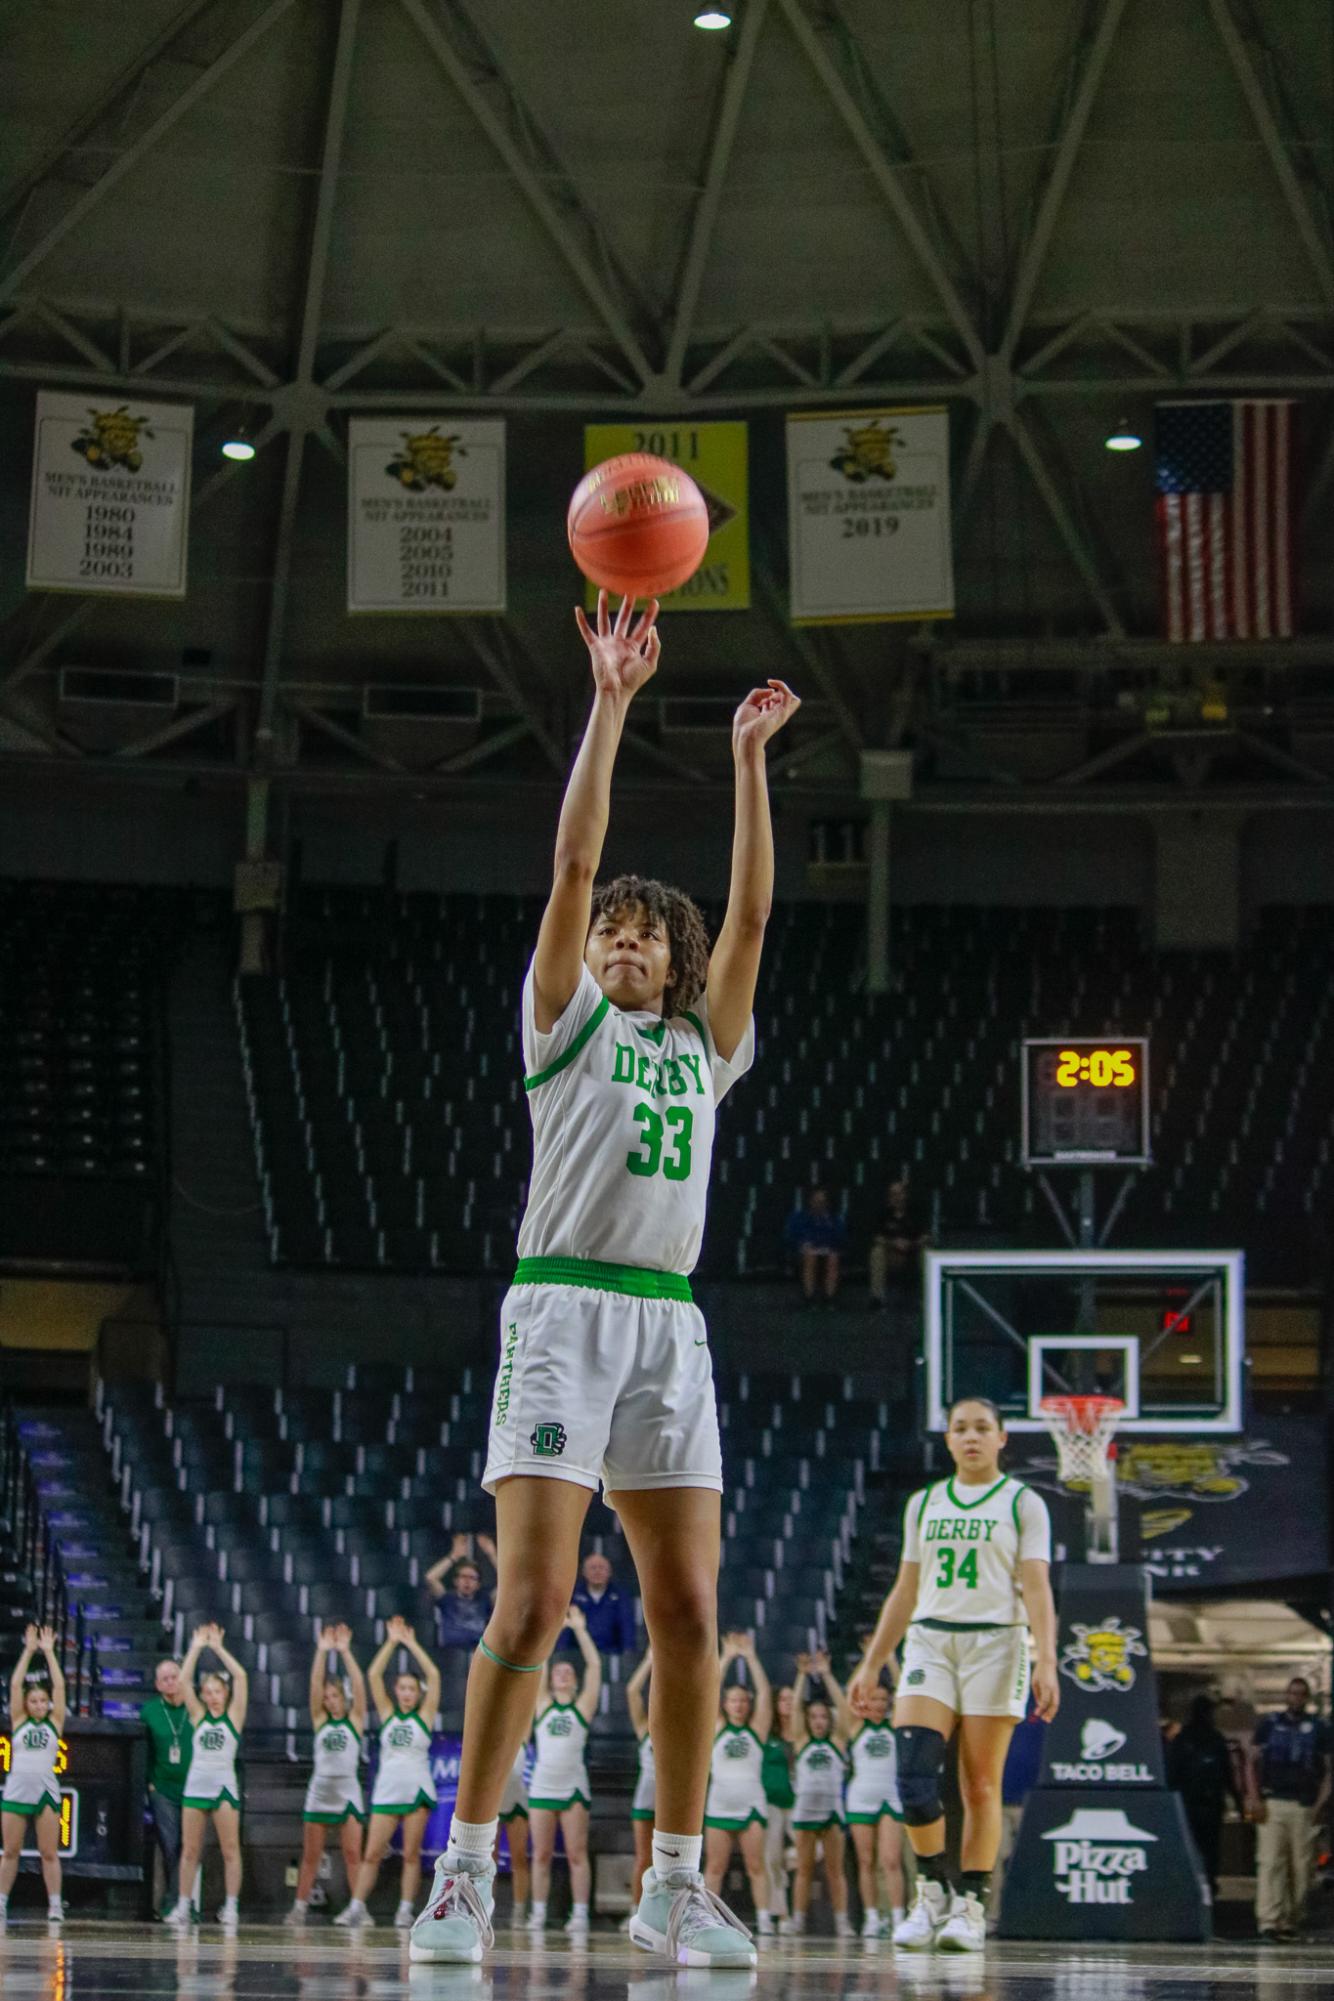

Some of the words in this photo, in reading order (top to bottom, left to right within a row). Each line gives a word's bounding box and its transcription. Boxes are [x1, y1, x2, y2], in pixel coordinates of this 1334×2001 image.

[86, 505, 135, 523] 1980
[86, 523, 133, 542] 1984
[843, 516, 898, 538] 2019
[401, 563, 452, 580] 2010
[401, 581, 449, 598] 2011
[611, 1041, 705, 1099] DERBY
[1057, 1050, 1135, 1087] 2:05
[626, 1102, 694, 1181] 33
[925, 1519, 998, 1542] DERBY
[937, 1547, 978, 1589] 34
[1051, 1763, 1102, 1781] TACO
[1105, 1763, 1154, 1781] BELL
[1054, 1841, 1148, 1875] Pizza
[1054, 1869, 1134, 1904] Hut
